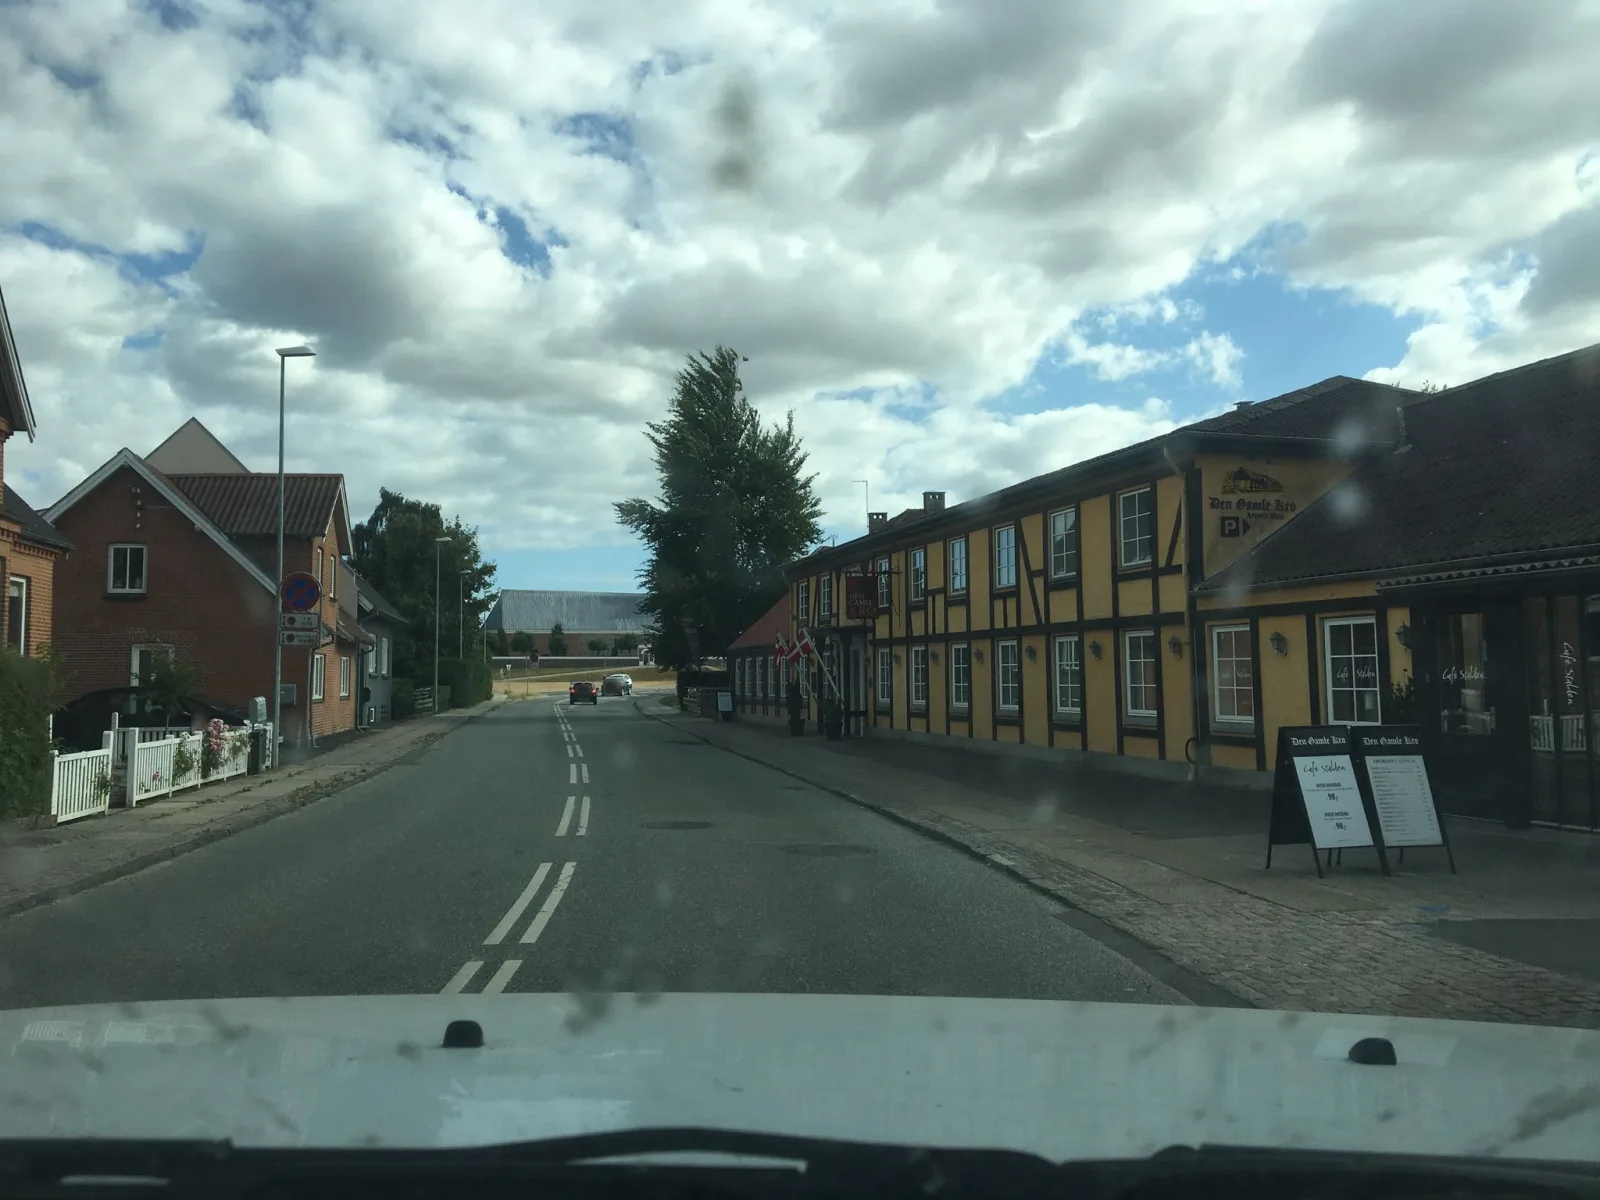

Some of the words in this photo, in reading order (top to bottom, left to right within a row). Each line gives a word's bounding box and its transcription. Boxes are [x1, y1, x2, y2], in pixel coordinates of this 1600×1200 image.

[1208, 496, 1231, 509] Den
[1236, 498, 1271, 511] Gamle
[1274, 499, 1296, 512] Kro
[1224, 519, 1237, 535] P
[1291, 737, 1307, 746] Den
[1307, 736, 1330, 746] Gamle
[1330, 736, 1346, 745] Kro
[1362, 737, 1379, 746] Den
[1380, 736, 1403, 746] Gamle
[1404, 736, 1419, 745] Kro
